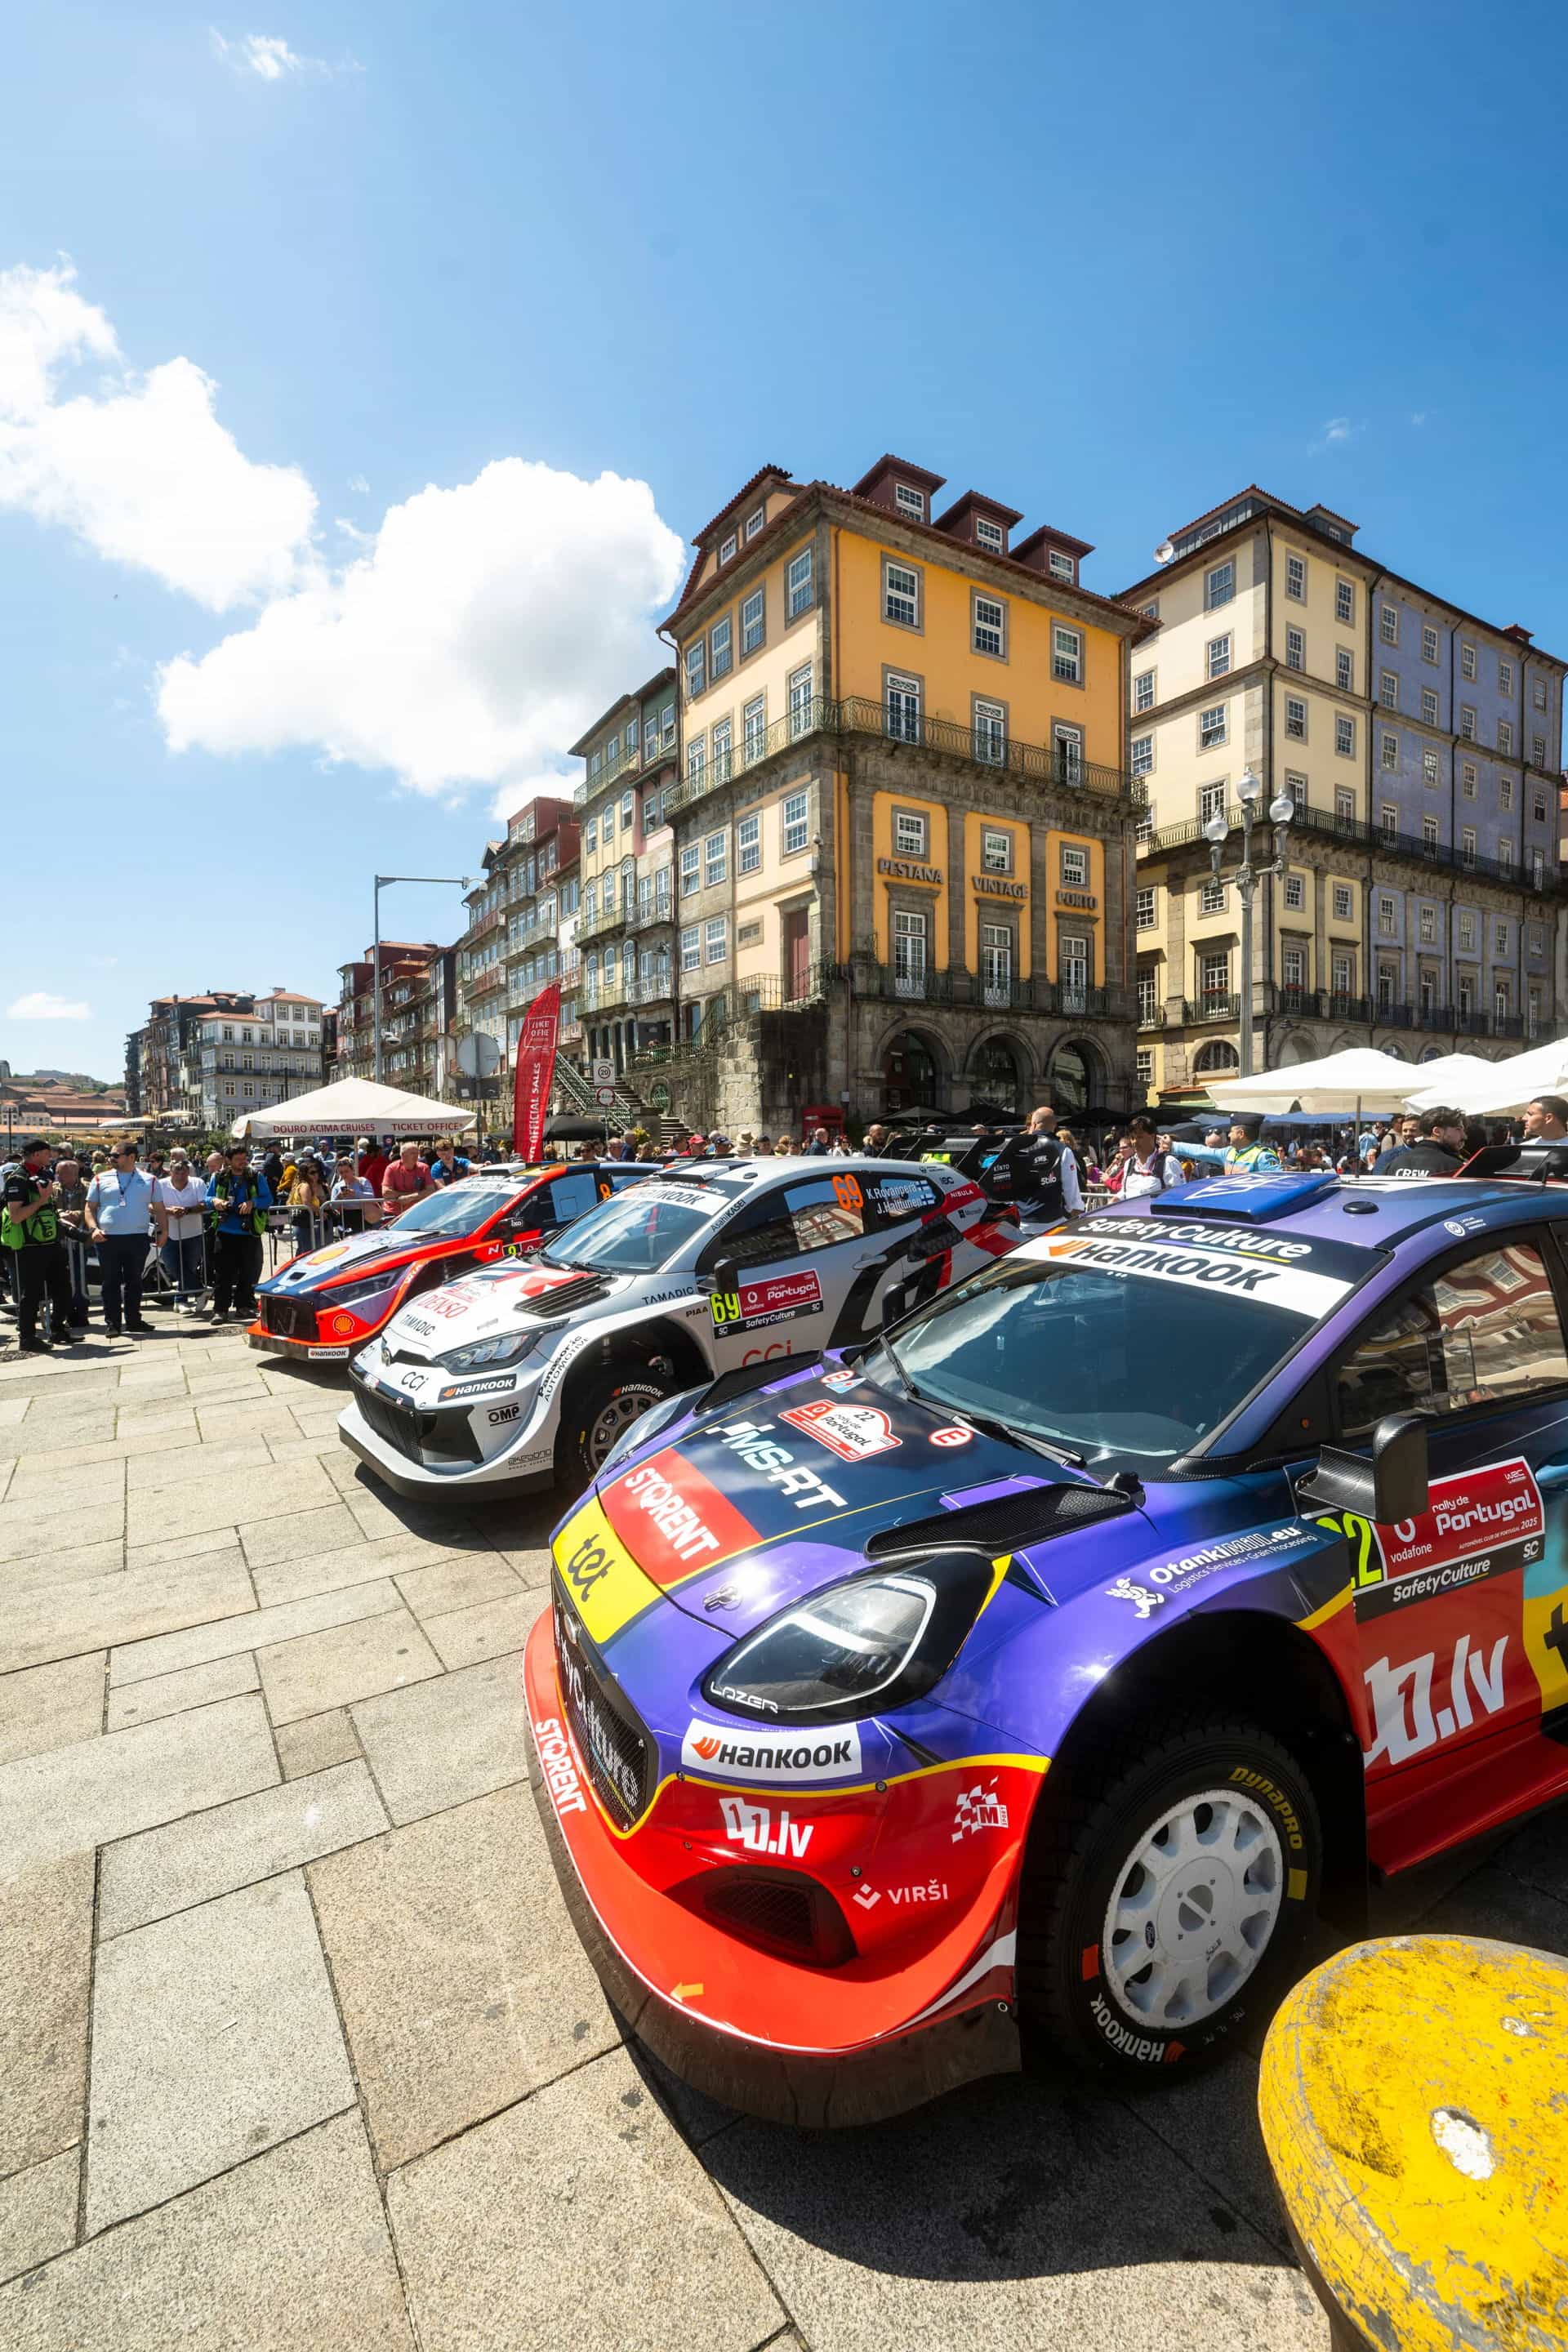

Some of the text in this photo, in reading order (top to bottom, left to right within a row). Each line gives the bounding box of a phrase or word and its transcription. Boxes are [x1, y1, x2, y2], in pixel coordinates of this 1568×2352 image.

[878, 858, 1098, 909] PESTANA VINTAGE PORTO
[532, 1062, 541, 1094] SALES
[273, 1123, 458, 1134] DOURO ACIMA CRUISES TICKET OFFICE
[529, 1098, 539, 1143] OFFICIAL
[1396, 1168, 1429, 1177] CREW
[831, 1174, 864, 1210] 69
[951, 1189, 973, 1198] NISULA
[1078, 1218, 1313, 1258] SafetyCulture
[417, 1294, 469, 1318] DENSO
[642, 1286, 694, 1305] TAMADIC
[767, 1281, 817, 1301] Portugal
[686, 1307, 709, 1318] PIAA
[710, 1293, 740, 1323] 69
[746, 1310, 795, 1329] SafetyCulture
[400, 1315, 435, 1337] TAMADIC
[719, 1326, 728, 1335] SC
[538, 1335, 582, 1397] Panasonic
[546, 1337, 589, 1403] AUTOMOTIVE
[454, 1379, 515, 1396] HANKOOK
[488, 1405, 520, 1423] OMP
[853, 1411, 876, 1423] 22
[822, 1415, 872, 1446] Portugal
[625, 1468, 720, 1561] STORENT
[1432, 1496, 1470, 1513] rally de
[1437, 1490, 1536, 1535] Portugal
[1521, 1517, 1538, 1530] 2025
[1149, 1526, 1303, 1584] OtankiMill.eu
[1168, 1535, 1318, 1593] Logistics Services Grain Processing
[1391, 1543, 1432, 1564] vodafone
[1523, 1540, 1539, 1558] SC
[568, 1534, 616, 1602] tet
[1392, 1558, 1490, 1603] SafetyCulture
[710, 1682, 778, 1714] LAZER
[535, 1717, 586, 1815] STORENT
[719, 1740, 853, 1770] HANKOOK
[719, 1797, 813, 1858] 11.lv
[888, 1878, 948, 1904] VIRŠI
